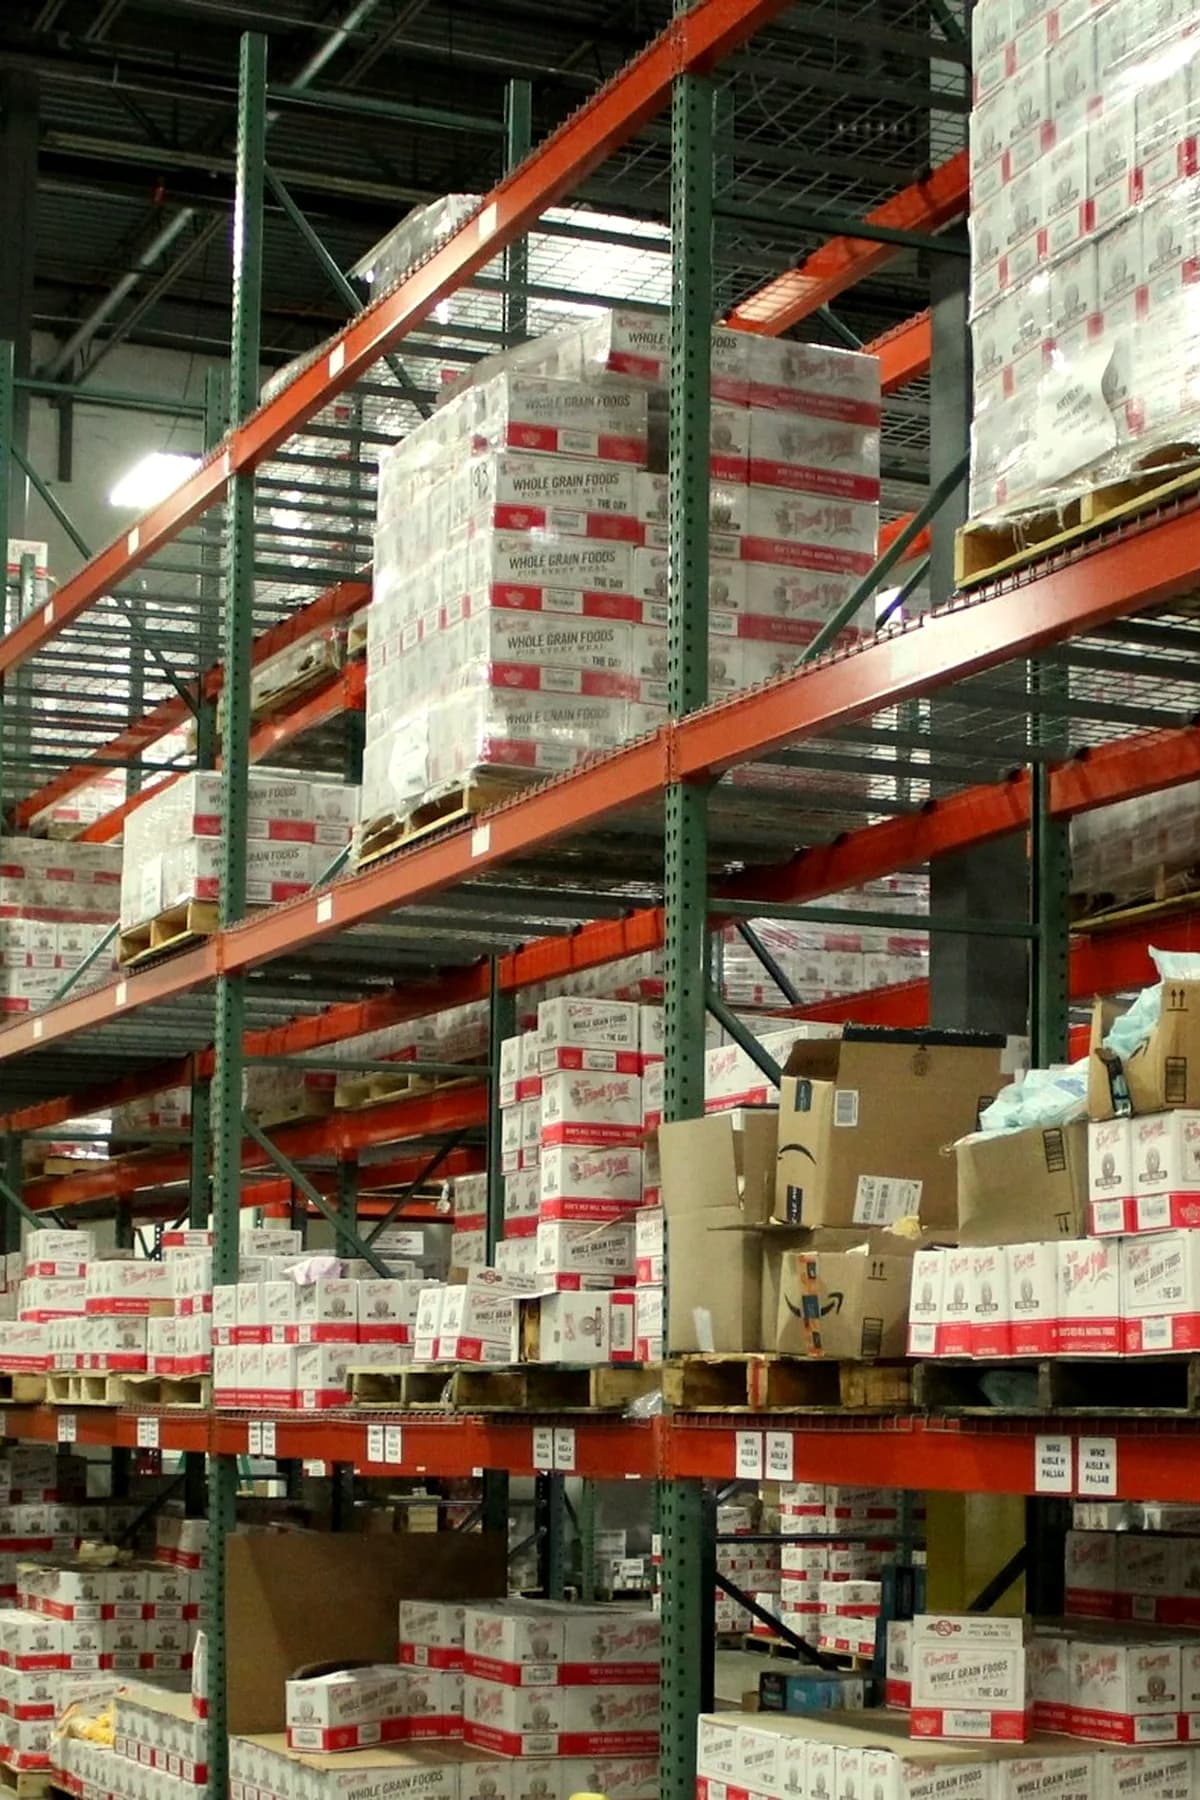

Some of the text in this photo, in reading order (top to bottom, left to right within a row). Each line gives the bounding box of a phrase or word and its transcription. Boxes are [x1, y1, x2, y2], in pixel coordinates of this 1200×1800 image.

[628, 332, 665, 344] WHOLE
[513, 473, 619, 490] WHOLE GRAIN FOODS
[509, 551, 615, 569] WHOLE GRAIN FOODS
[507, 629, 614, 648] WHOLE GRAIN FOODS
[269, 785, 297, 798] FOODS
[270, 848, 300, 860] FOODS
[930, 1661, 1008, 1684] WHOLE GRAIN FOODS
[978, 1688, 1008, 1698] THE DAY
[910, 1770, 982, 1798] WHOLE GRAIN FOODS
[1016, 1767, 1088, 1794] WHOLE GRAIN FOODS
[1118, 1761, 1188, 1790] WHOLE GRAIN FOODS
[347, 1771, 444, 1799] WHOLE GRAIN FOODS
[1162, 1790, 1173, 1799] THE
